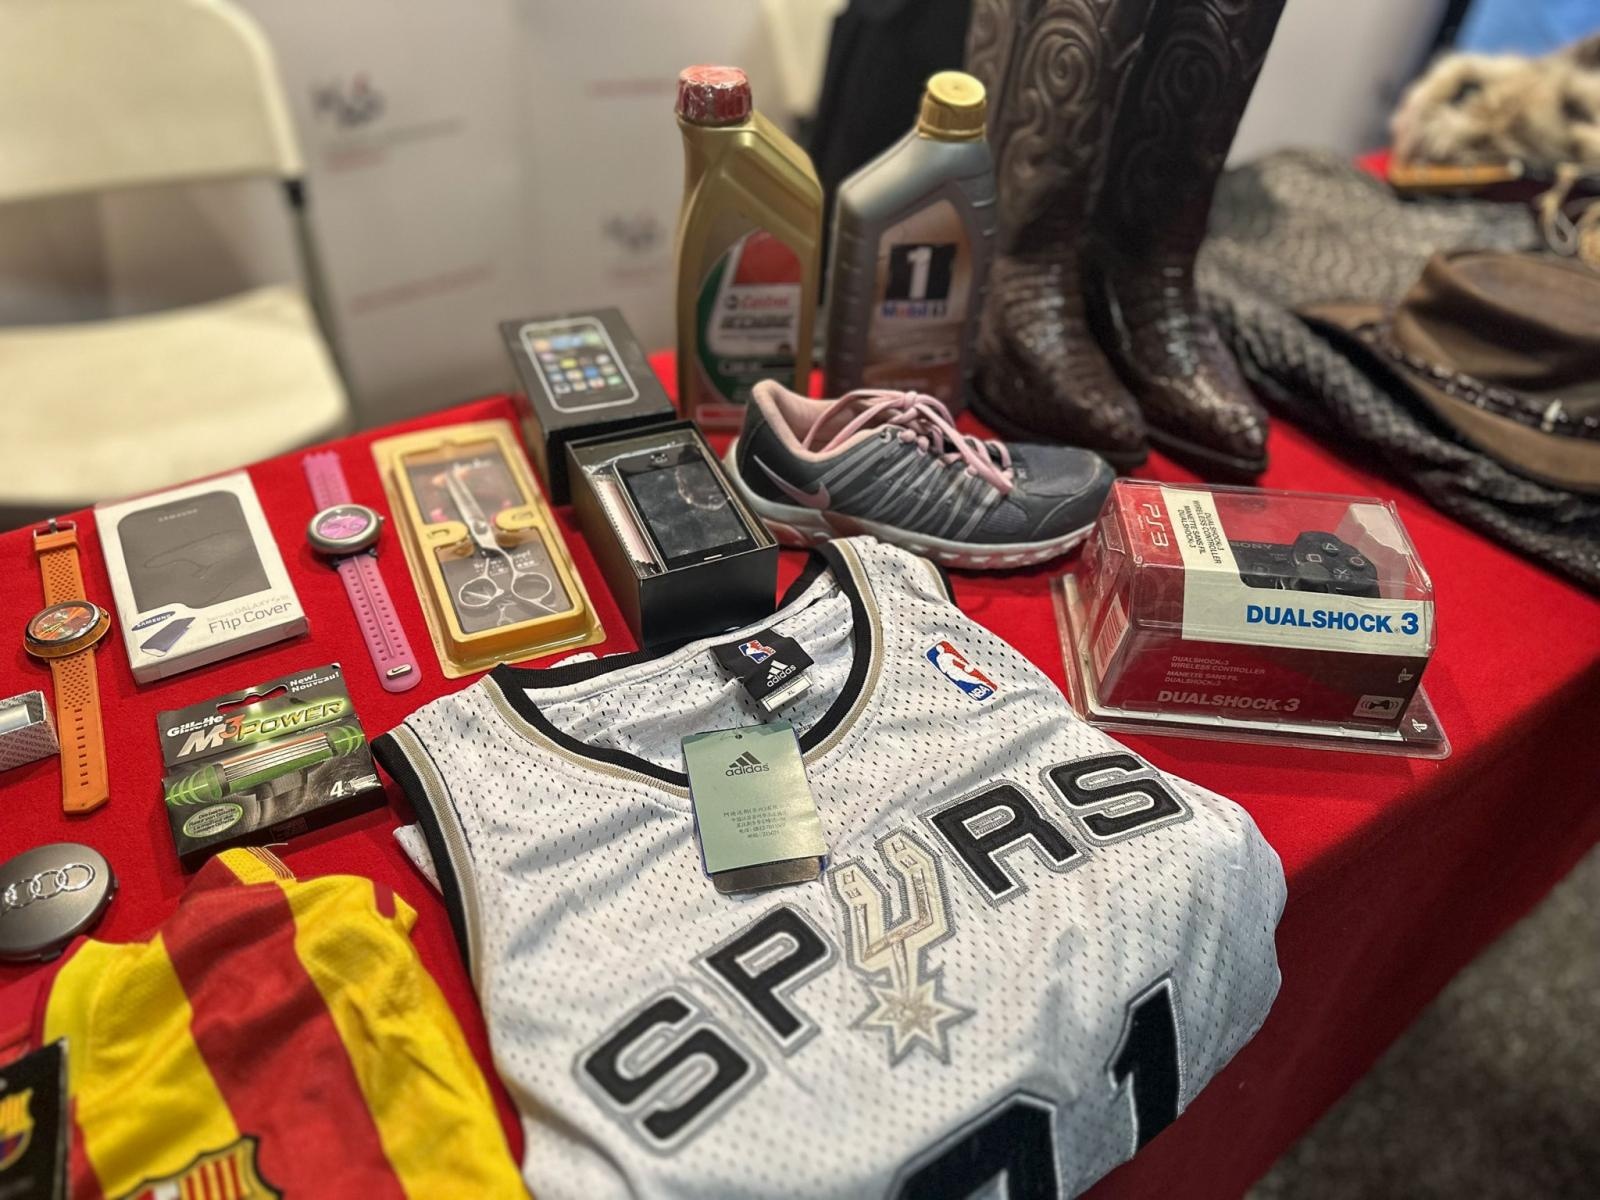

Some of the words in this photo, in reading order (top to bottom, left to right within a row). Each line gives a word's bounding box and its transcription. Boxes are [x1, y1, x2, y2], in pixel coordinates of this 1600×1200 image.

[907, 246, 933, 299] 1
[1142, 503, 1169, 547] PS3
[1184, 505, 1197, 530] MANETTE
[1192, 500, 1207, 527] WIRELESS
[1203, 526, 1222, 564] CONTROLLER
[1230, 541, 1273, 550] SONY
[208, 618, 241, 634] Flip
[244, 602, 292, 624] Cover
[767, 665, 797, 688] adidas
[1167, 671, 1203, 679] MANETTE
[1171, 662, 1210, 671] WIRELESS
[1212, 665, 1266, 675] CONTROLLER
[290, 673, 317, 687] New!
[292, 672, 340, 692] Nouveau!
[968, 684, 991, 700] NBA
[167, 714, 223, 737] Gillette
[725, 764, 769, 776] adidas
[330, 780, 344, 798] 4
